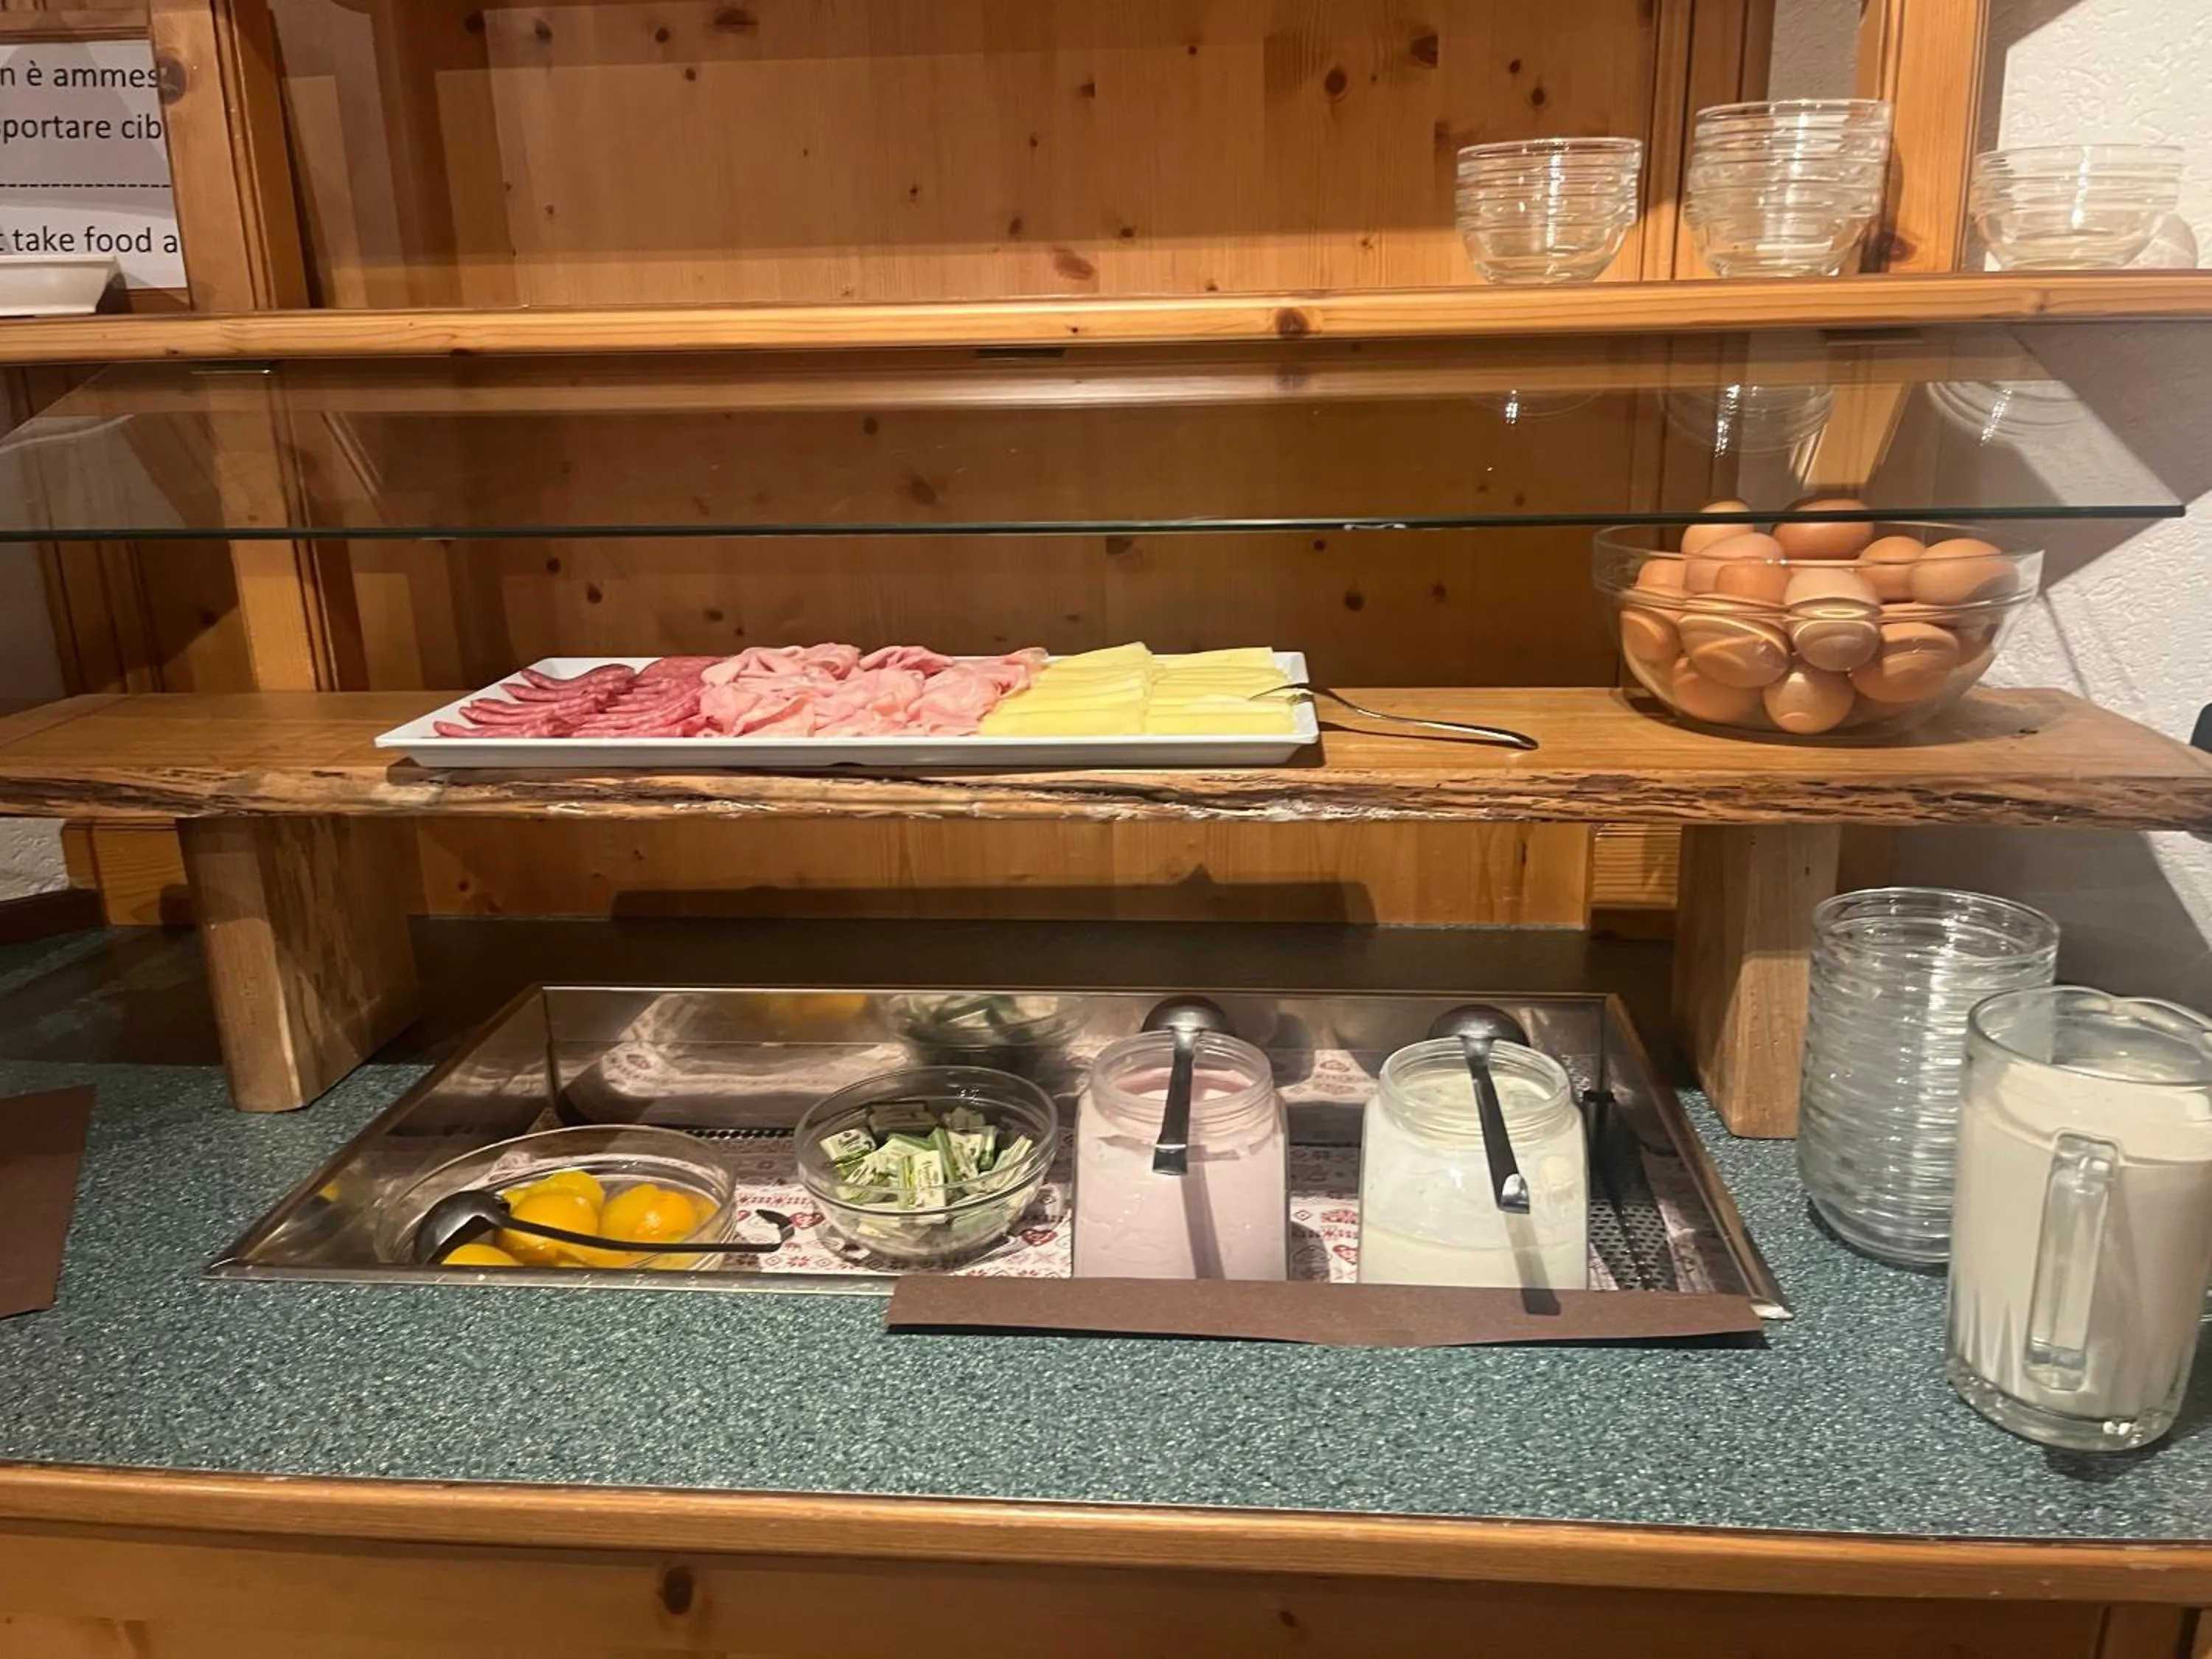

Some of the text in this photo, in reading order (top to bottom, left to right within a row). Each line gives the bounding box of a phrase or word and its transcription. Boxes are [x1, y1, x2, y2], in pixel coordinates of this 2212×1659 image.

[0, 60, 158, 88] n è ammes
[0, 113, 161, 145] portare cib
[12, 226, 75, 252] take
[85, 226, 152, 253] food
[163, 234, 178, 253] a
